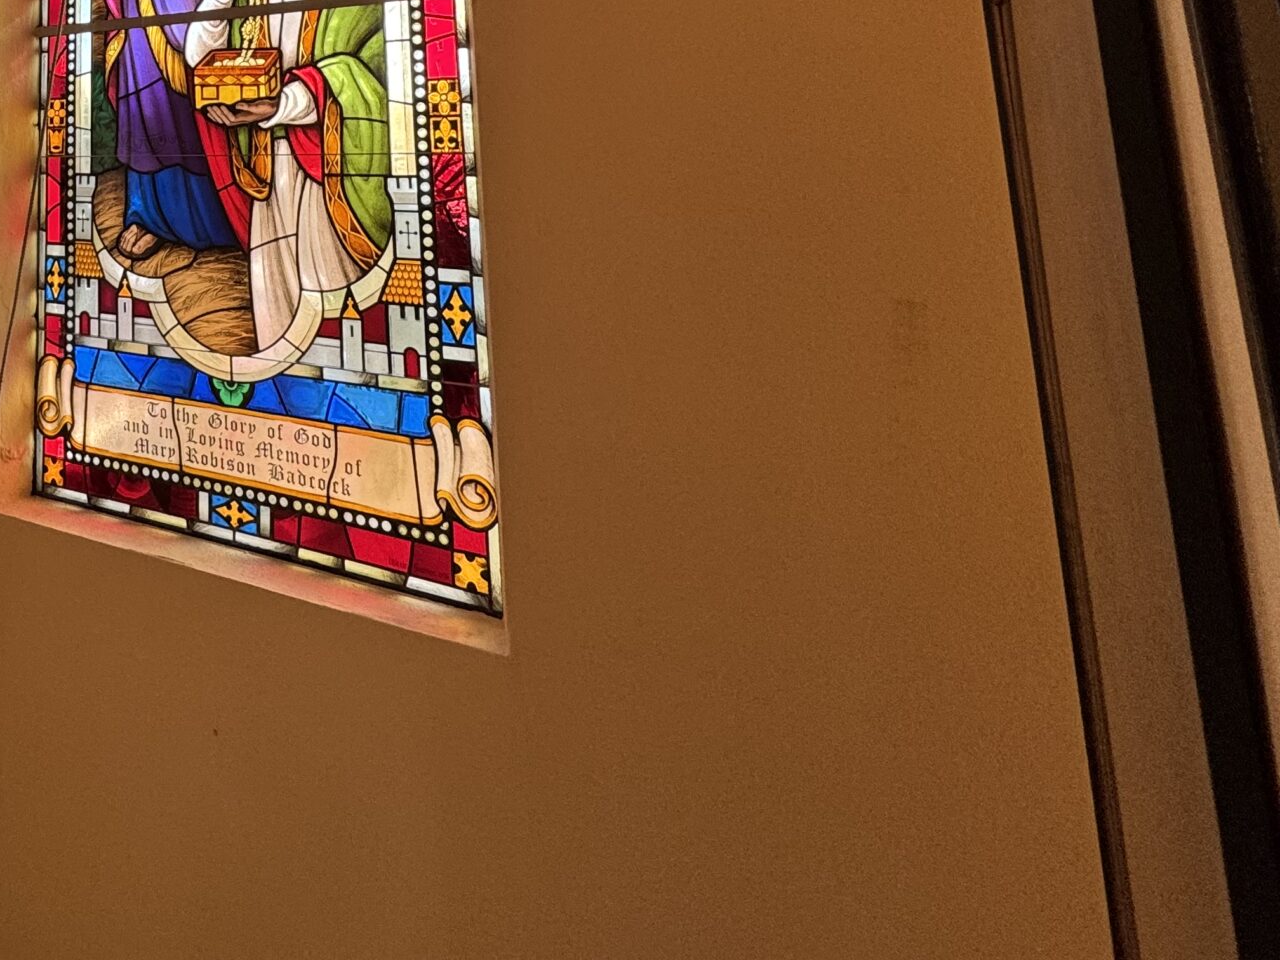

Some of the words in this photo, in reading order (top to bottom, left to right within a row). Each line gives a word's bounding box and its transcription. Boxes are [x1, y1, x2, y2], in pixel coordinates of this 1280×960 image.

[123, 420, 149, 435] and
[159, 422, 173, 439] in
[185, 426, 245, 456] Loving
[255, 441, 330, 473] Memory
[345, 459, 362, 477] of
[146, 401, 167, 419] To
[176, 407, 199, 425] the
[208, 412, 256, 439] Glory
[267, 424, 284, 441] of
[294, 427, 332, 449] God
[133, 437, 176, 462] Mary
[185, 445, 256, 476] Robison
[268, 462, 351, 496] Badcock
